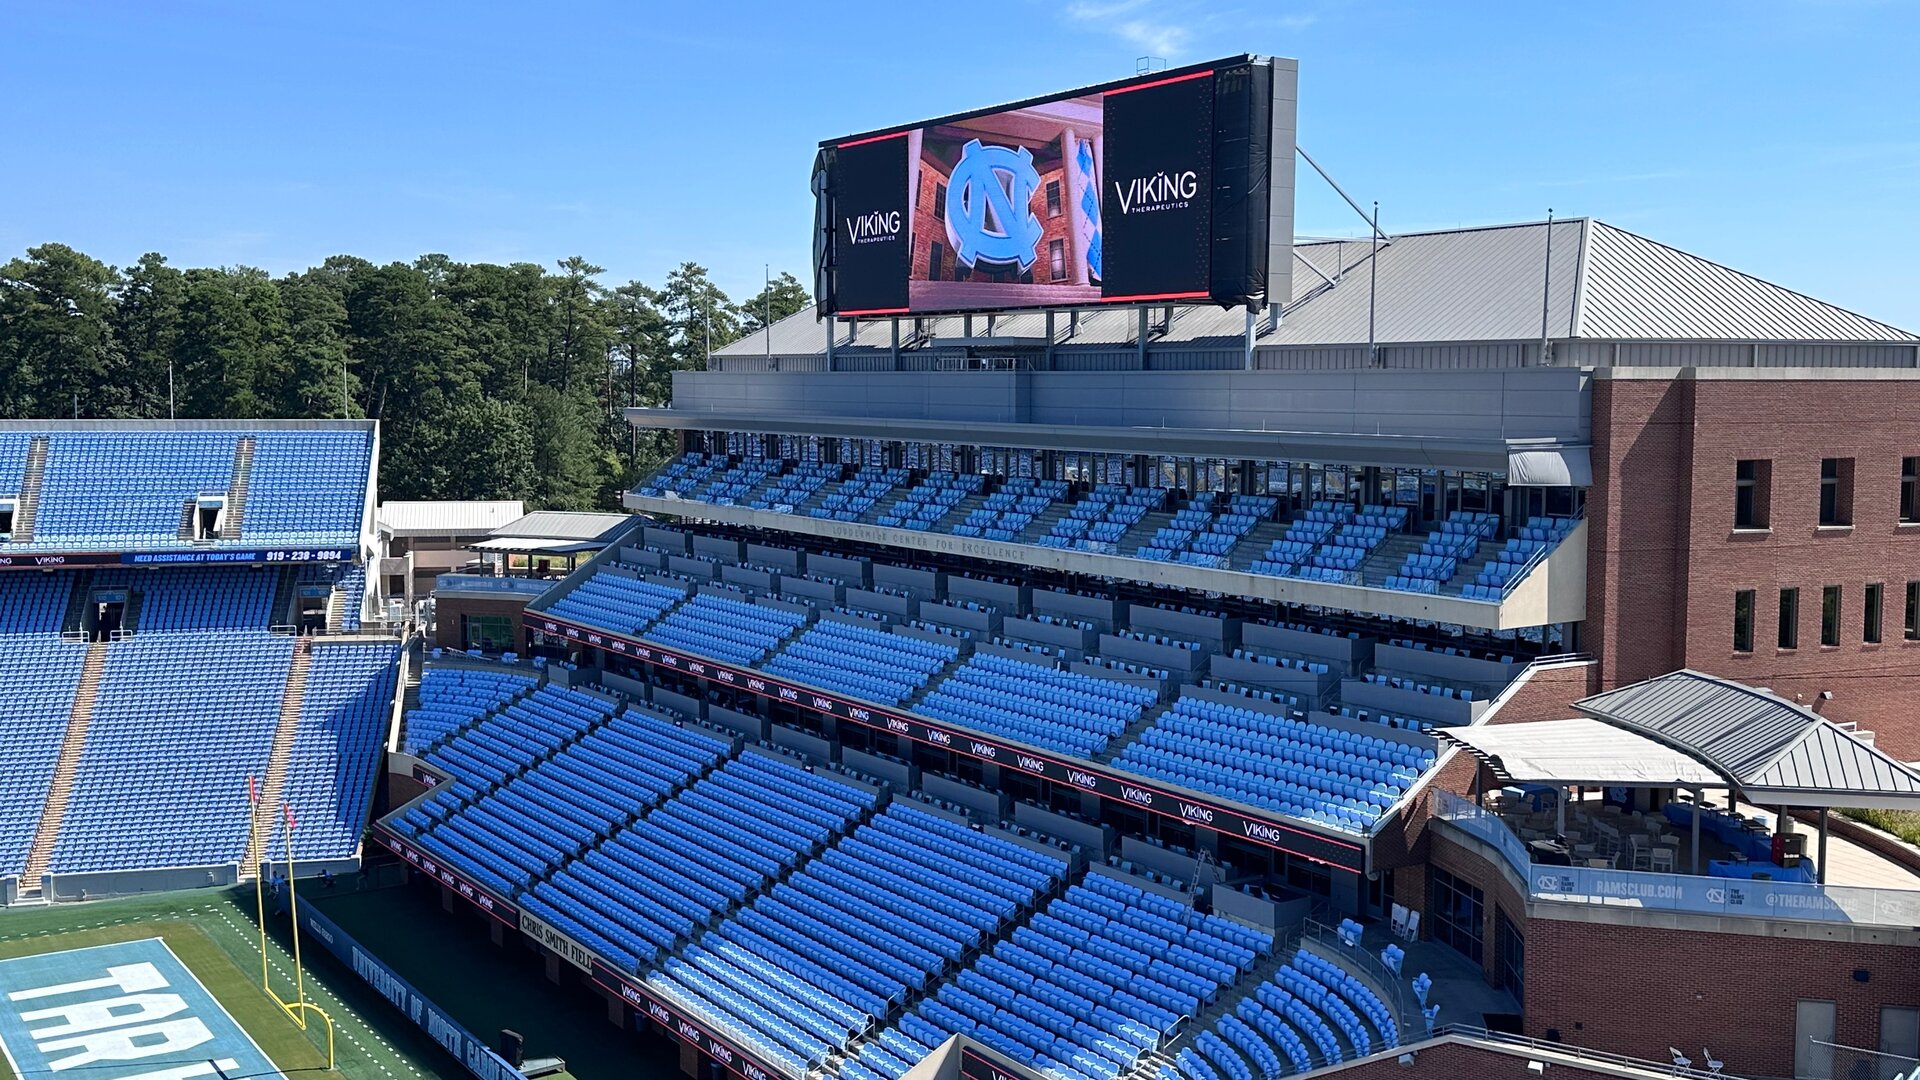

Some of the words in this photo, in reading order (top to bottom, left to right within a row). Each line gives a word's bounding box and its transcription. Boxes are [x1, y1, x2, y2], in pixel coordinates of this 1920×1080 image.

[1115, 171, 1197, 214] VIKING
[1131, 201, 1189, 213] THERAPEUTICS
[846, 211, 900, 245] VIKING
[35, 556, 65, 565] VIKING
[153, 554, 195, 562] ASSISTANCE
[893, 534, 928, 549] CENTER
[936, 540, 953, 550] FOR
[962, 543, 1025, 560] EXCELLENCE
[779, 687, 797, 700] VIKING
[812, 696, 832, 710] VIKING
[848, 707, 869, 721] VIKING
[886, 717, 909, 732] VIKING
[927, 729, 950, 744] VIKING
[970, 741, 996, 757] VIKING
[1016, 754, 1044, 772] VIKING
[1066, 769, 1096, 787] VIKING
[1120, 785, 1152, 804] VIKING
[1179, 802, 1213, 822] VIKING
[1243, 821, 1280, 842] VIKING
[1596, 880, 1683, 900] RAMSCLUB.COM
[521, 915, 544, 940] CHRIS
[545, 929, 569, 956] SMITH
[571, 945, 593, 970] FIELD
[8, 962, 214, 1072] TAR
[621, 983, 641, 1003] VIKING
[649, 1001, 670, 1022] VIKING
[678, 1019, 700, 1041] VIKING
[709, 1039, 732, 1062] VIKING
